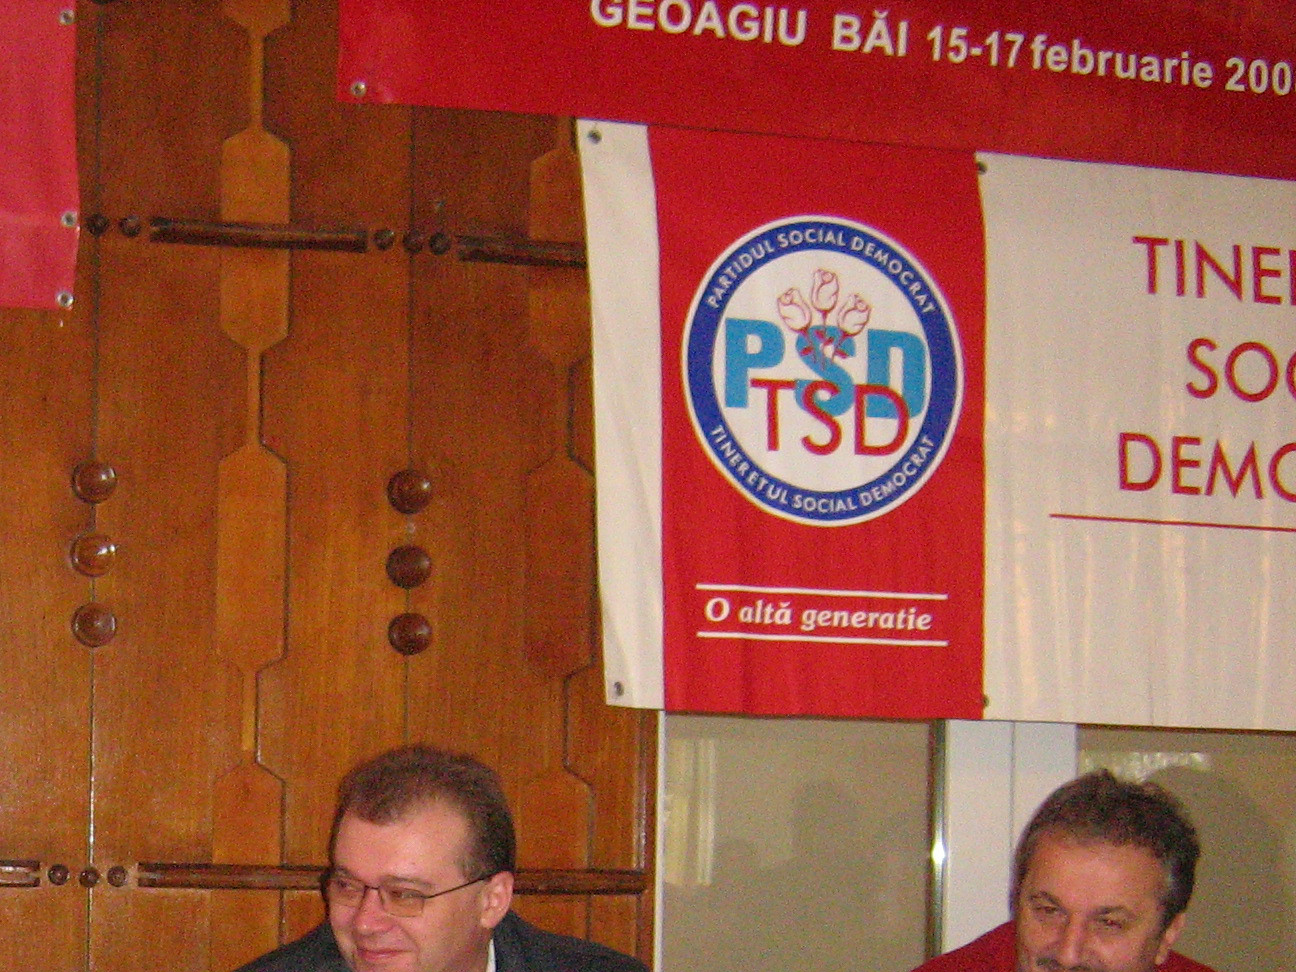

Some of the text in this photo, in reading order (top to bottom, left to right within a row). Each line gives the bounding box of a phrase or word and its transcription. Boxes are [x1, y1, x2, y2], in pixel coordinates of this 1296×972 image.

[589, 0, 807, 47] GEOAGIU
[831, 10, 909, 58] BĂI
[1224, 57, 1296, 96] 200
[706, 228, 936, 315] PARTIDUL SOCIAL DEMOCRAT
[1131, 235, 1296, 306] TINE
[1185, 337, 1296, 403] SO
[749, 378, 910, 456] TSD
[710, 424, 936, 514] TINERETUL SOCIAL DEMOCRAT
[705, 597, 730, 622] O
[738, 600, 793, 626] altă
